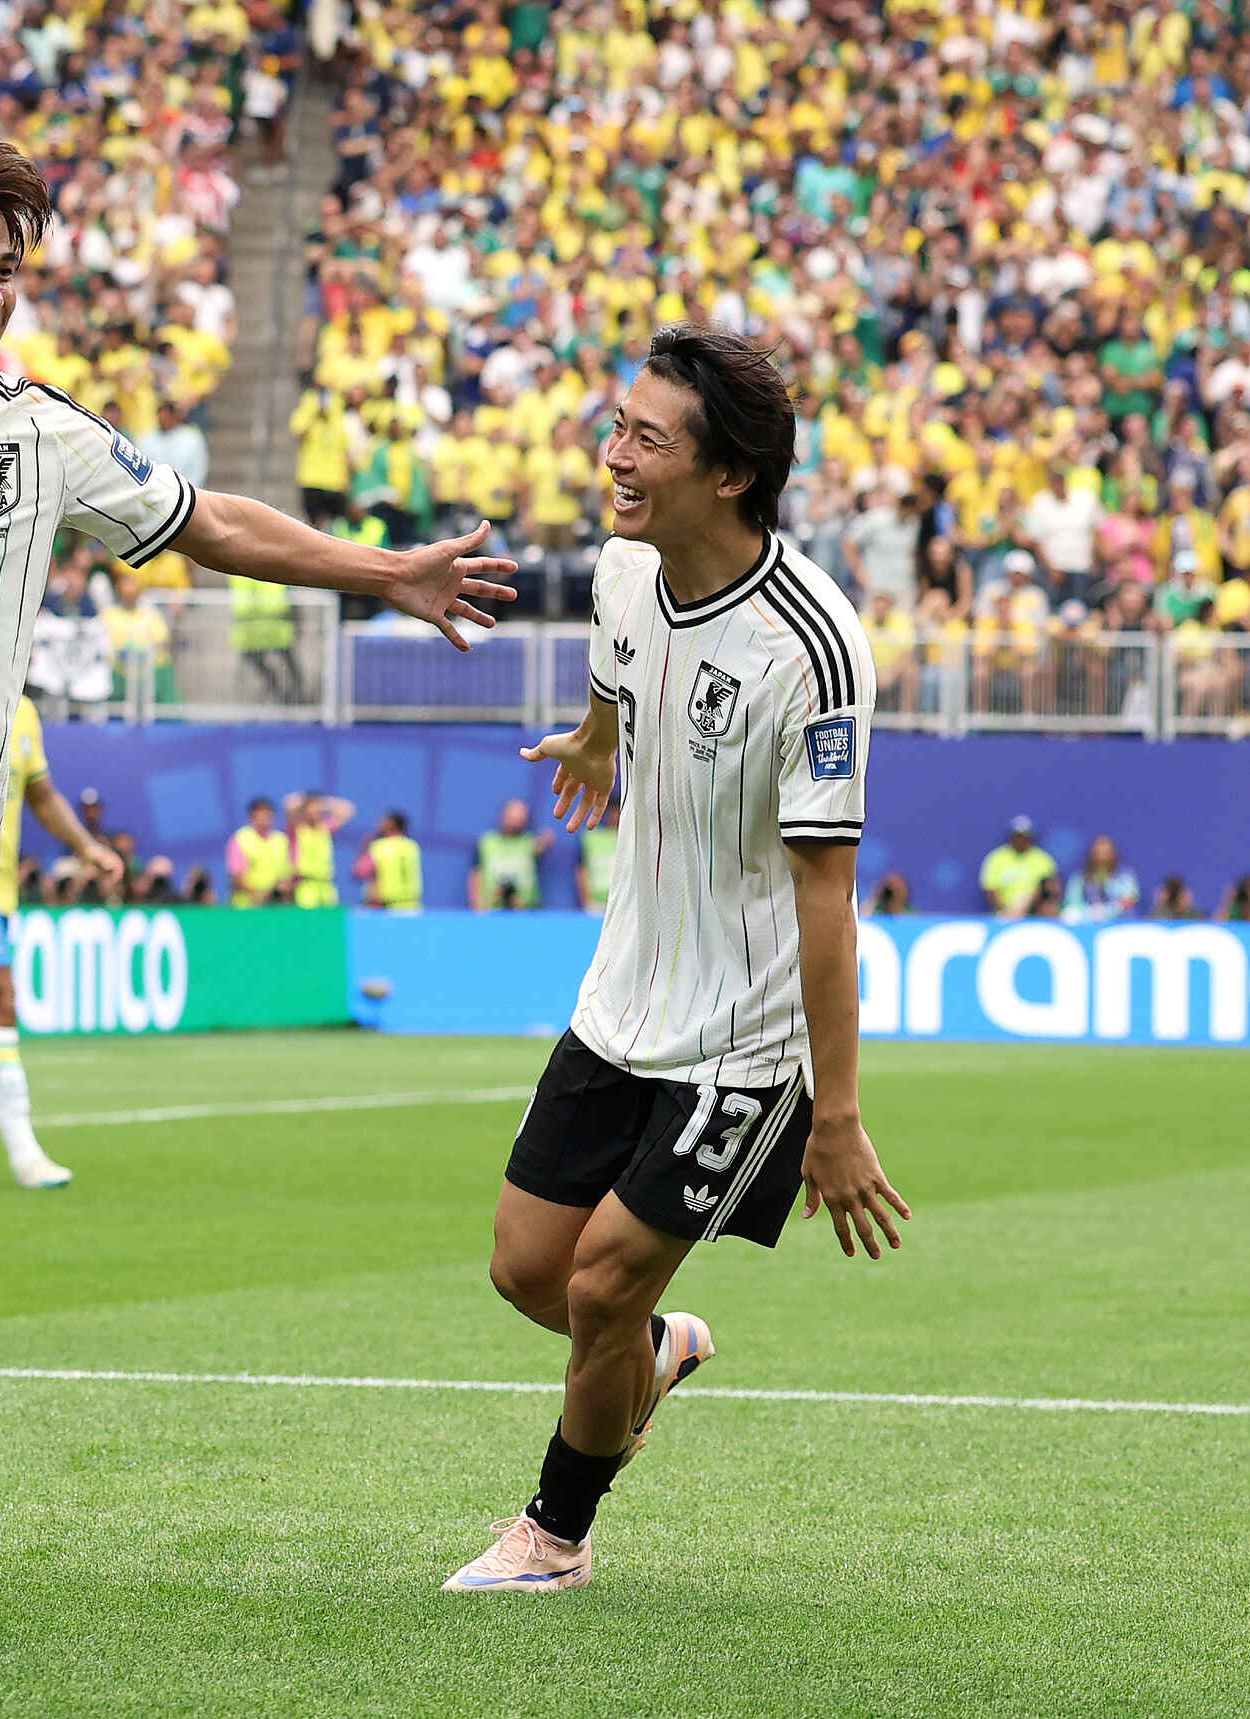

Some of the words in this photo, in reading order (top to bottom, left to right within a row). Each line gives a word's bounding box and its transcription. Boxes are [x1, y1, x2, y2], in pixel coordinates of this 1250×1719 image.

[709, 666, 733, 684] JAPAN
[696, 712, 717, 731] JFA
[814, 727, 849, 740] FOOTBALL
[816, 737, 849, 752] UNITES
[9, 908, 188, 1033] amco
[672, 1083, 763, 1173] 13
